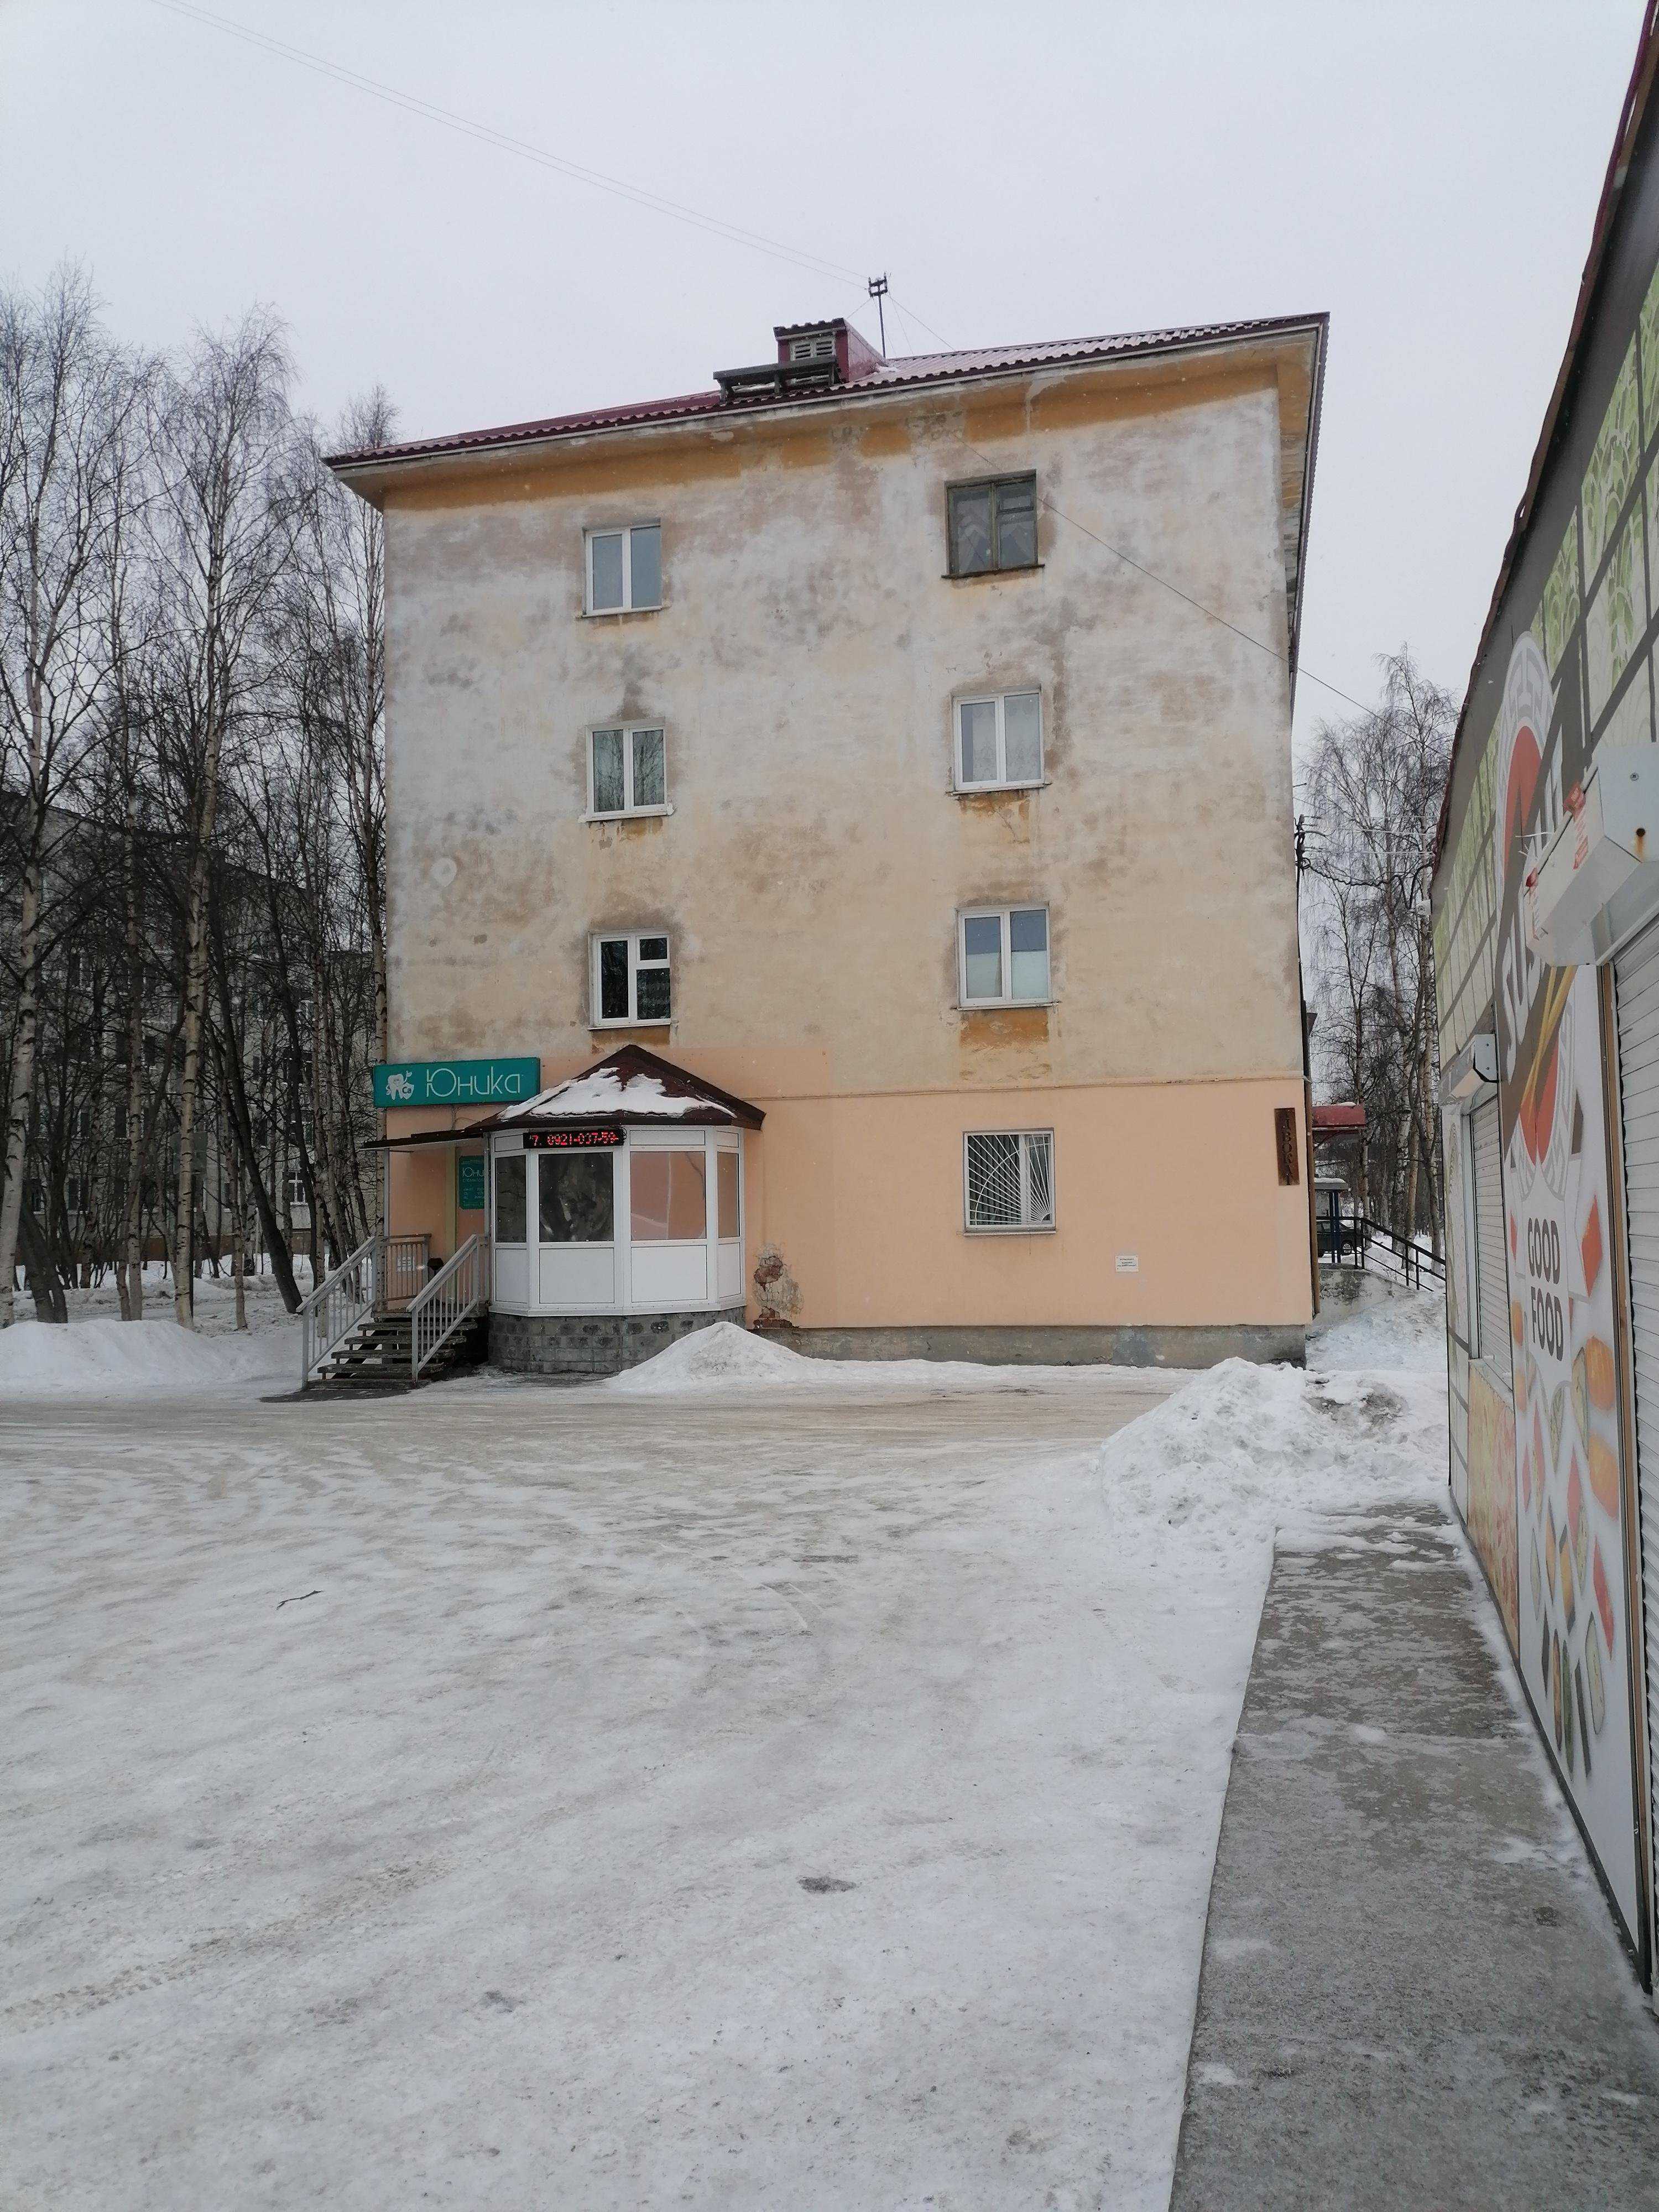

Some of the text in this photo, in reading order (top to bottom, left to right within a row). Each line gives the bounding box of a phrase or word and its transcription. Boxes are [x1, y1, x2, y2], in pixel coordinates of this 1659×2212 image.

[426, 1066, 520, 1097] Юника
[1528, 1218, 1561, 1285] GOOD
[1531, 1286, 1564, 1361] FOOD
